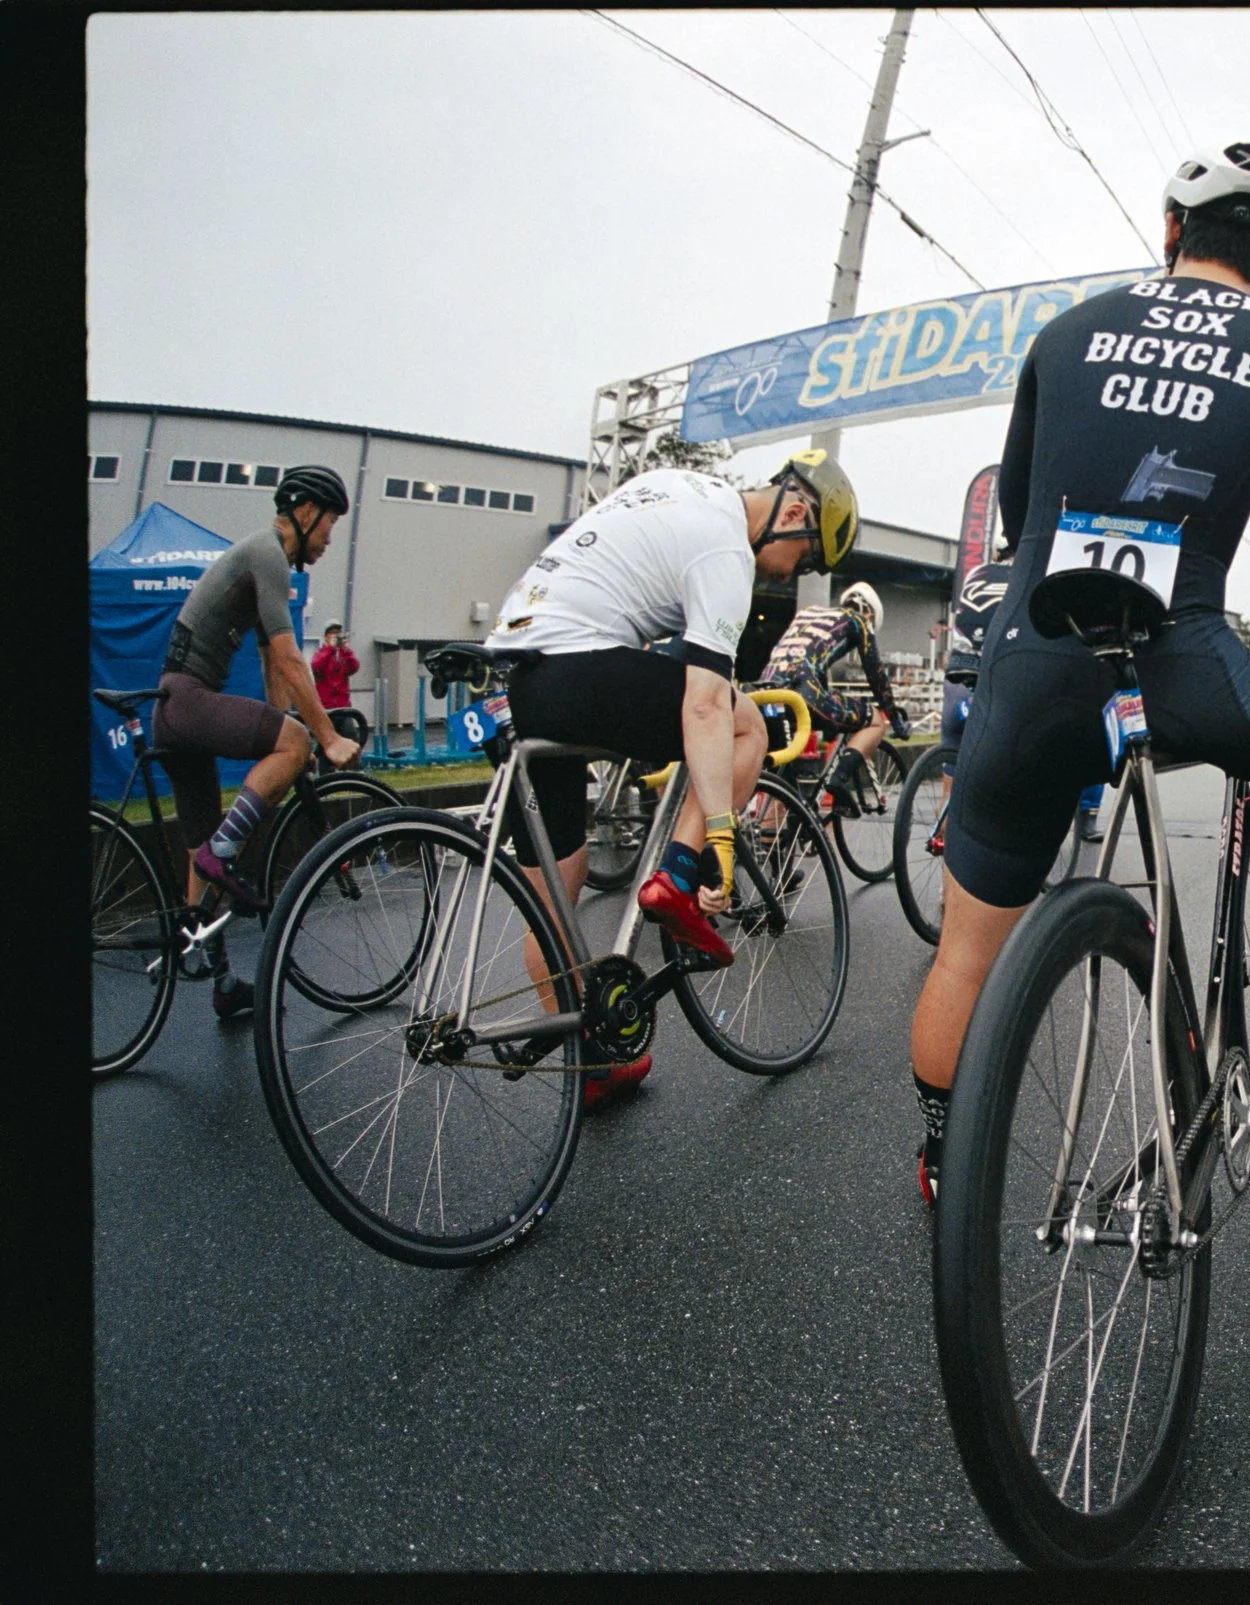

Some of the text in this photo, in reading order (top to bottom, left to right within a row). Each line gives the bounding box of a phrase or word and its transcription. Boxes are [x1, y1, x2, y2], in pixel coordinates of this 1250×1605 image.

[1140, 306, 1235, 337] SOX
[1100, 373, 1215, 422] CLUB
[1083, 541, 1146, 583] 10
[960, 701, 969, 717] 6
[108, 725, 127, 749] 16
[466, 711, 484, 743] 8
